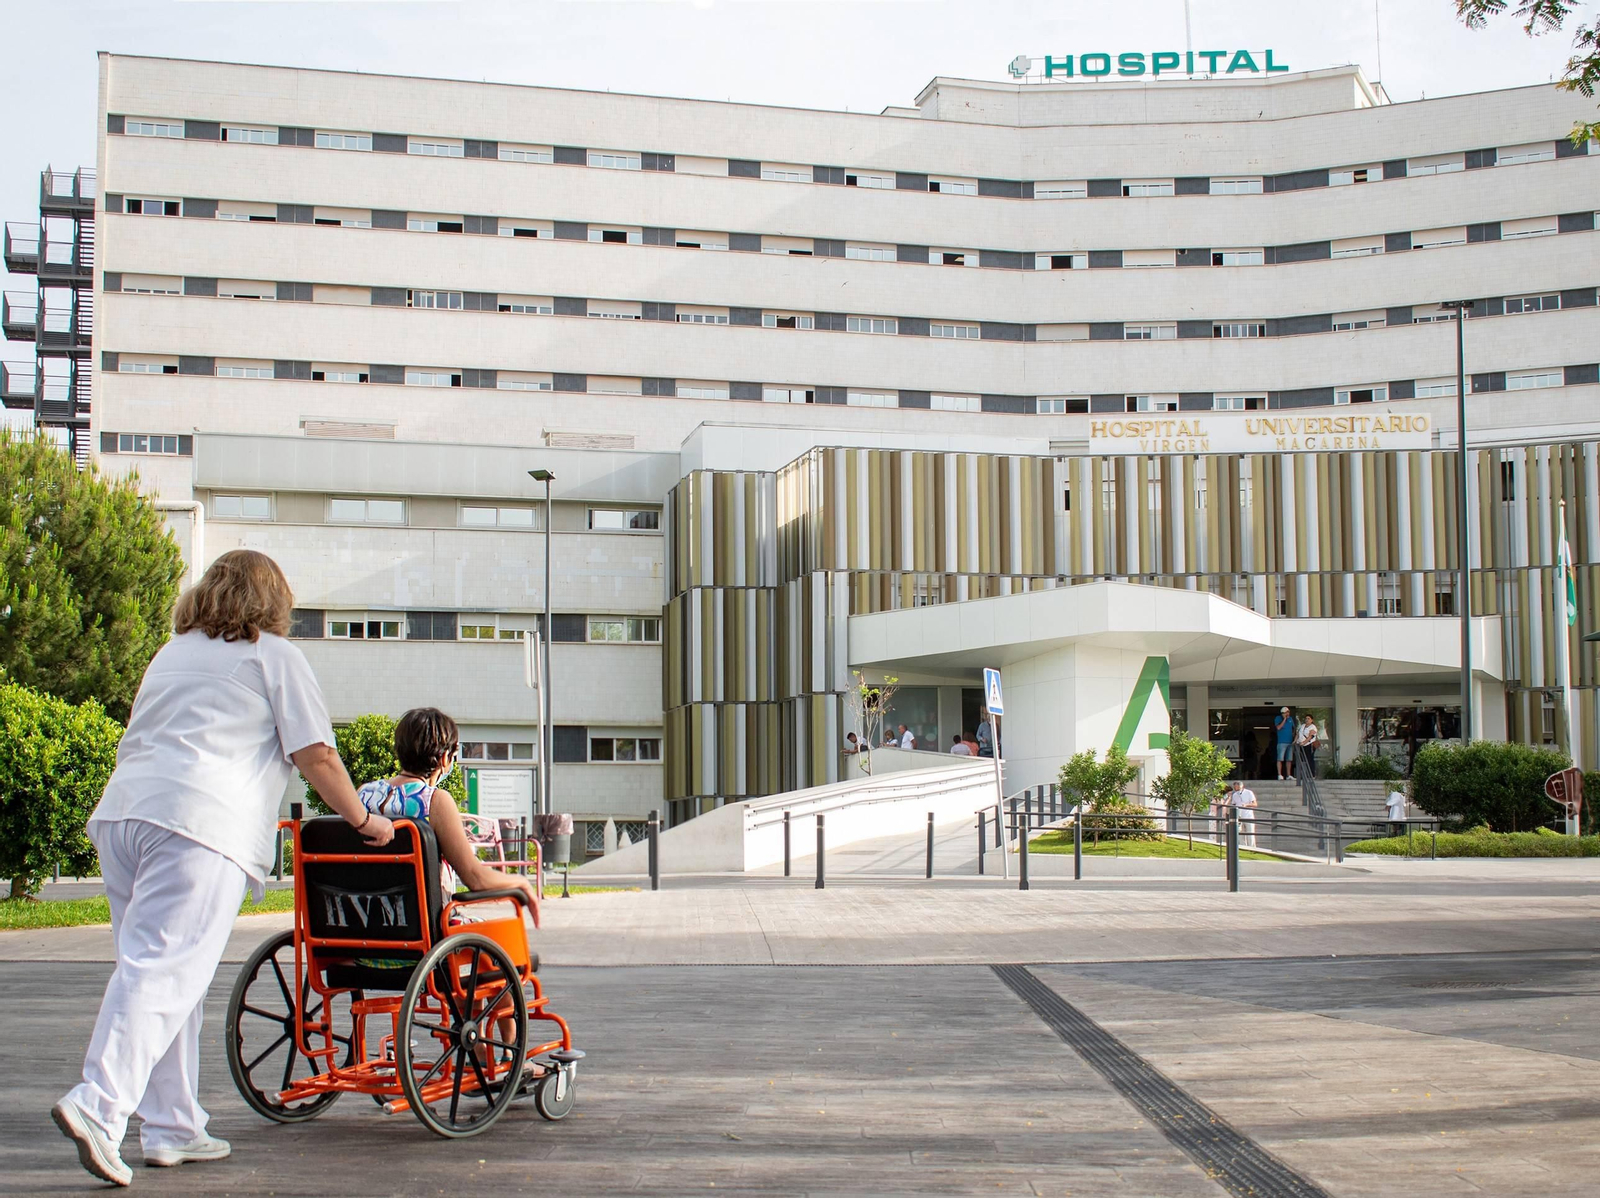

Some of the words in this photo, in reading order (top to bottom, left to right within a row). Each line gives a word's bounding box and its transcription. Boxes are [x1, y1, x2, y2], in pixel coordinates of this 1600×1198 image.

[1044, 49, 1289, 78] HOSPITAL
[1091, 420, 1208, 438] HOSPITAL
[1245, 415, 1429, 435] UNIVERSITARIO
[1139, 439, 1210, 453] VIRGEN
[1276, 437, 1381, 450] MACARENA
[324, 893, 409, 928] HVM
